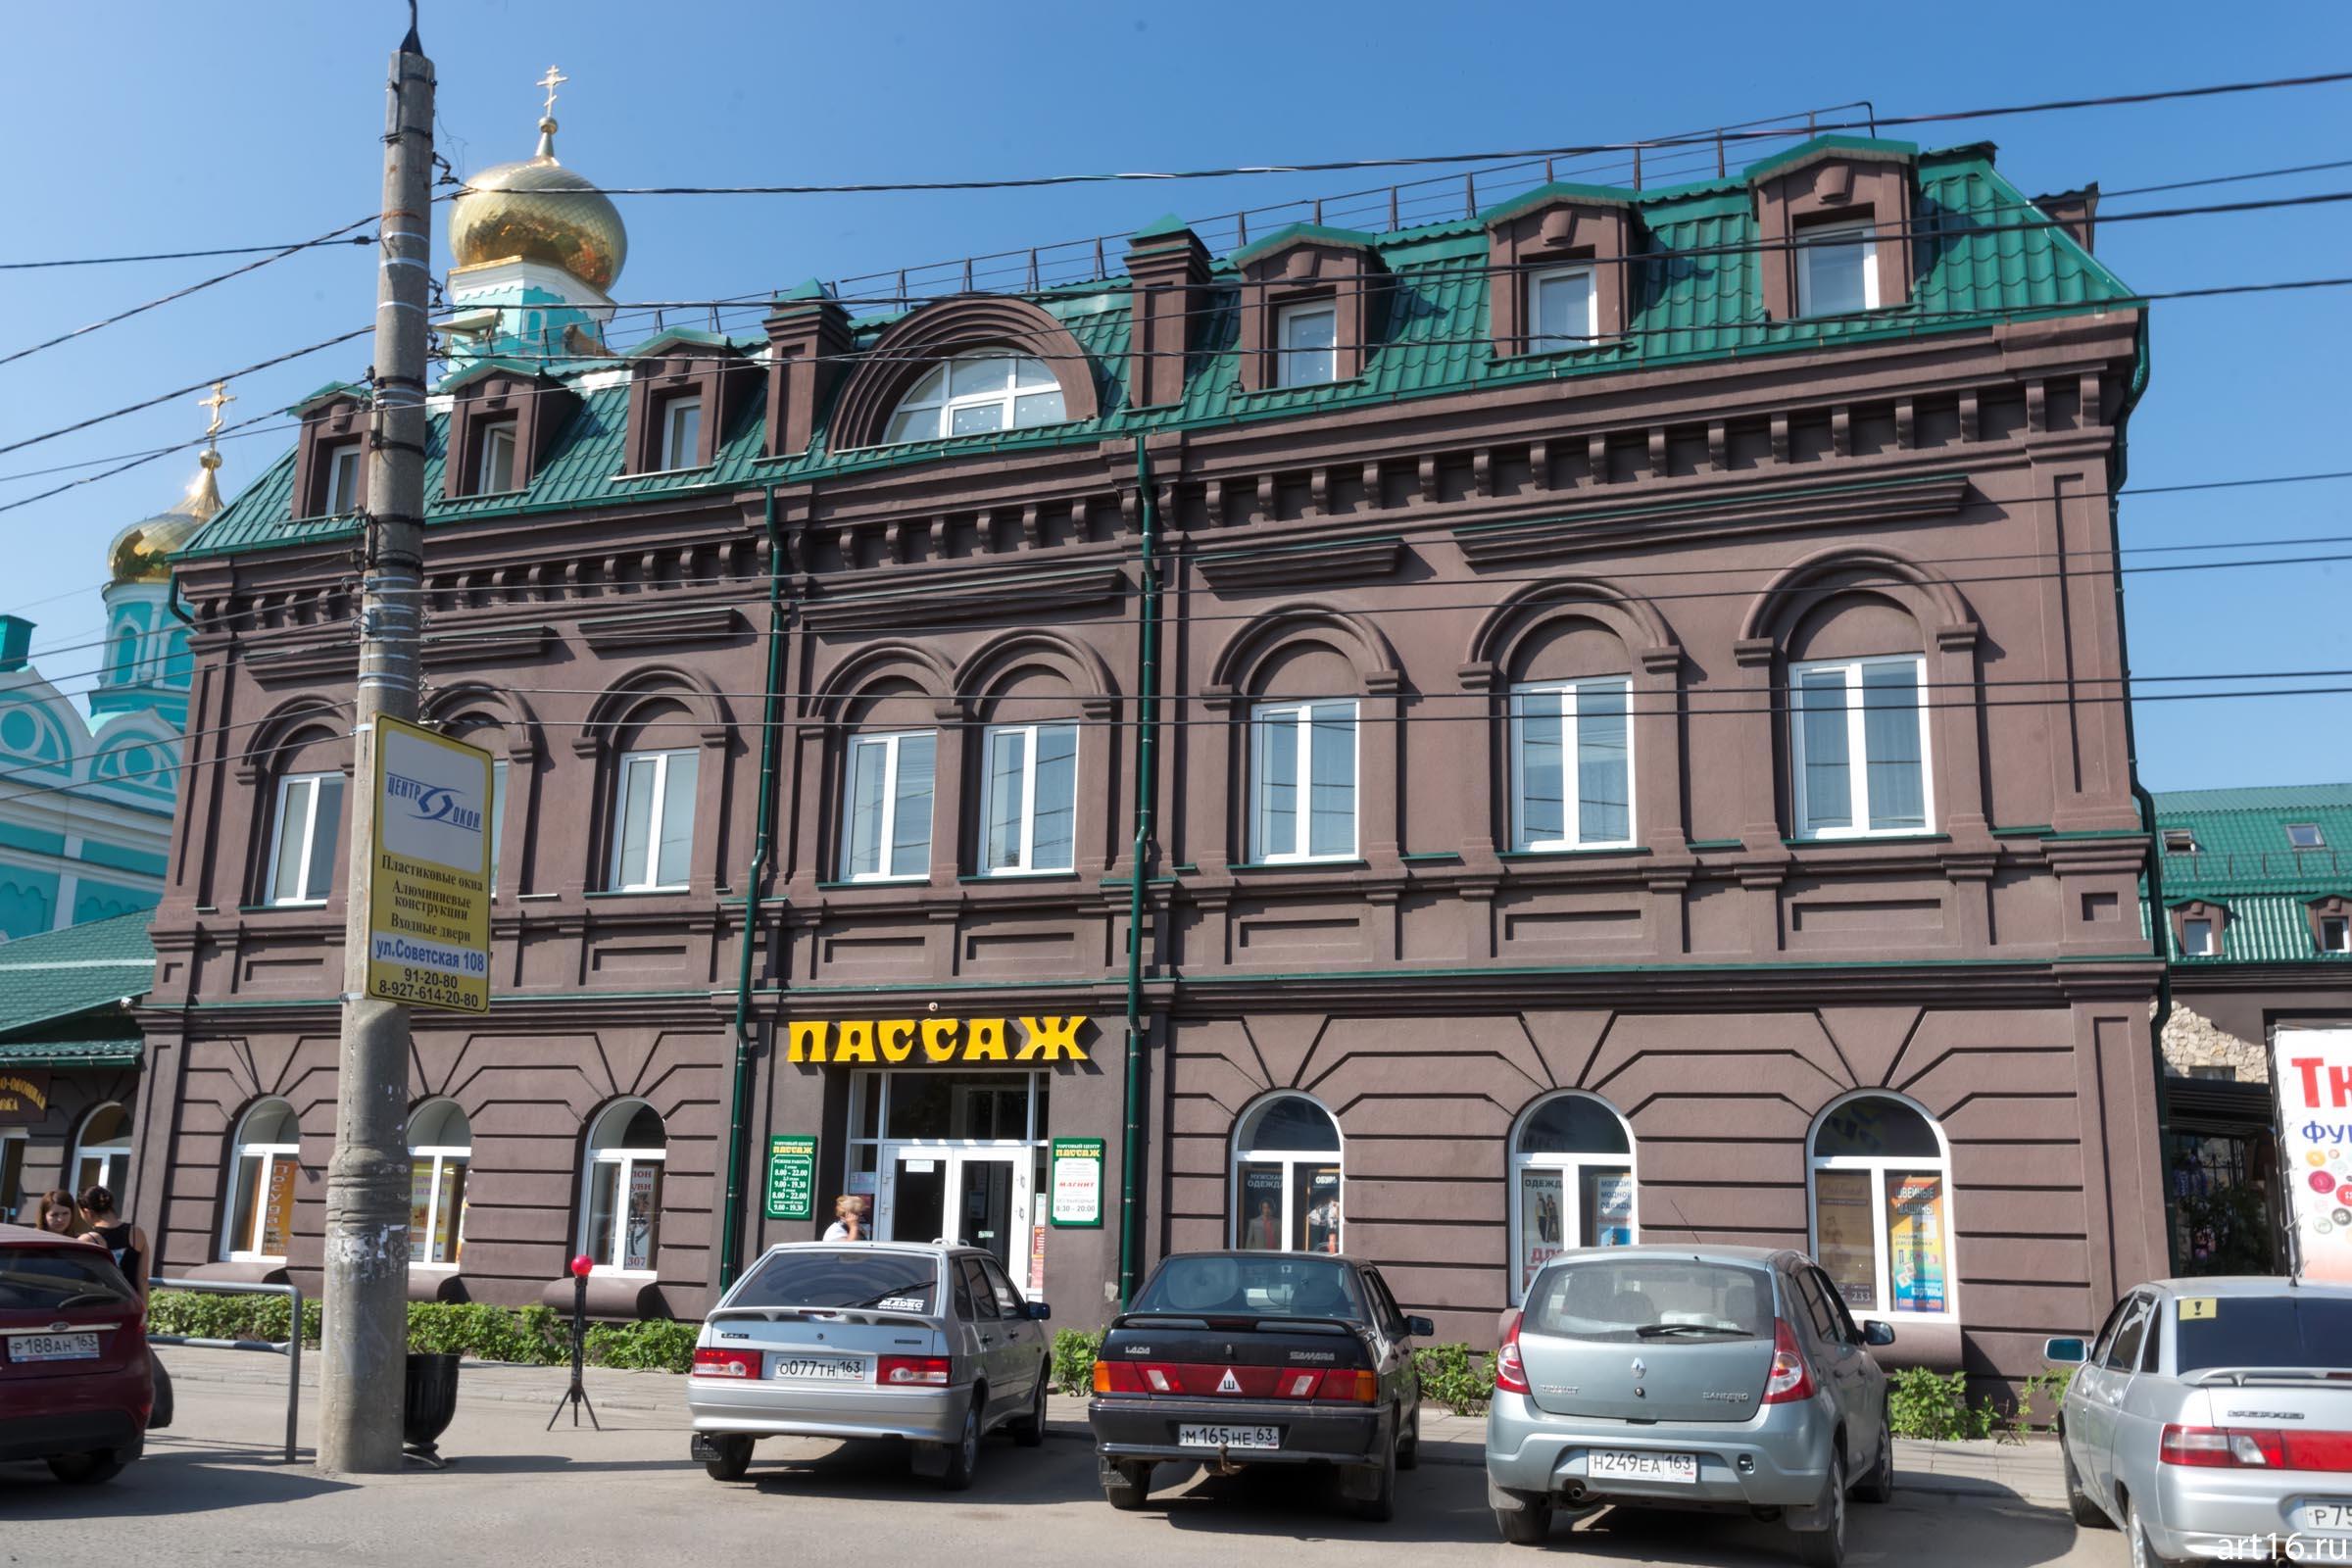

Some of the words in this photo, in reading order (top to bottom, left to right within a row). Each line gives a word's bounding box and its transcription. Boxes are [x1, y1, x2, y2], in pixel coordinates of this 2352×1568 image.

[388, 776, 421, 801] ЦЕНТР
[453, 807, 480, 829] ОКОН
[382, 854, 457, 886] Пластиковые
[458, 877, 483, 892] окна
[393, 879, 471, 908] Алюминиевые
[395, 896, 468, 921] конструкции
[391, 912, 438, 936] Входные
[439, 925, 471, 944] двери
[376, 939, 460, 968] ул.Советская
[463, 951, 484, 972] 108
[404, 967, 458, 989] 91-20-80
[379, 979, 478, 1007] 8-927-614-20-80
[787, 1016, 1091, 1063] ПАССАЖ
[772, 1146, 812, 1154] ПАССАЖ
[1055, 1149, 1101, 1157] ПАССАЖ
[1525, 1179, 1562, 1189] ОДЕЖД
[1895, 1185, 1935, 1199] ШВЕЙНЫЕ
[1897, 1202, 1934, 1215] МАШИНЫ
[14, 1337, 72, 1354] Р188АН
[75, 1335, 95, 1348] 163
[780, 1360, 835, 1377] О077ТН
[840, 1361, 860, 1373] 163
[1223, 1380, 1236, 1390] Ш
[1185, 1427, 1251, 1446] М165НЕ
[1256, 1428, 1273, 1442] 63
[1593, 1452, 1661, 1473] Н249ЕА
[1665, 1454, 1690, 1470] 163
